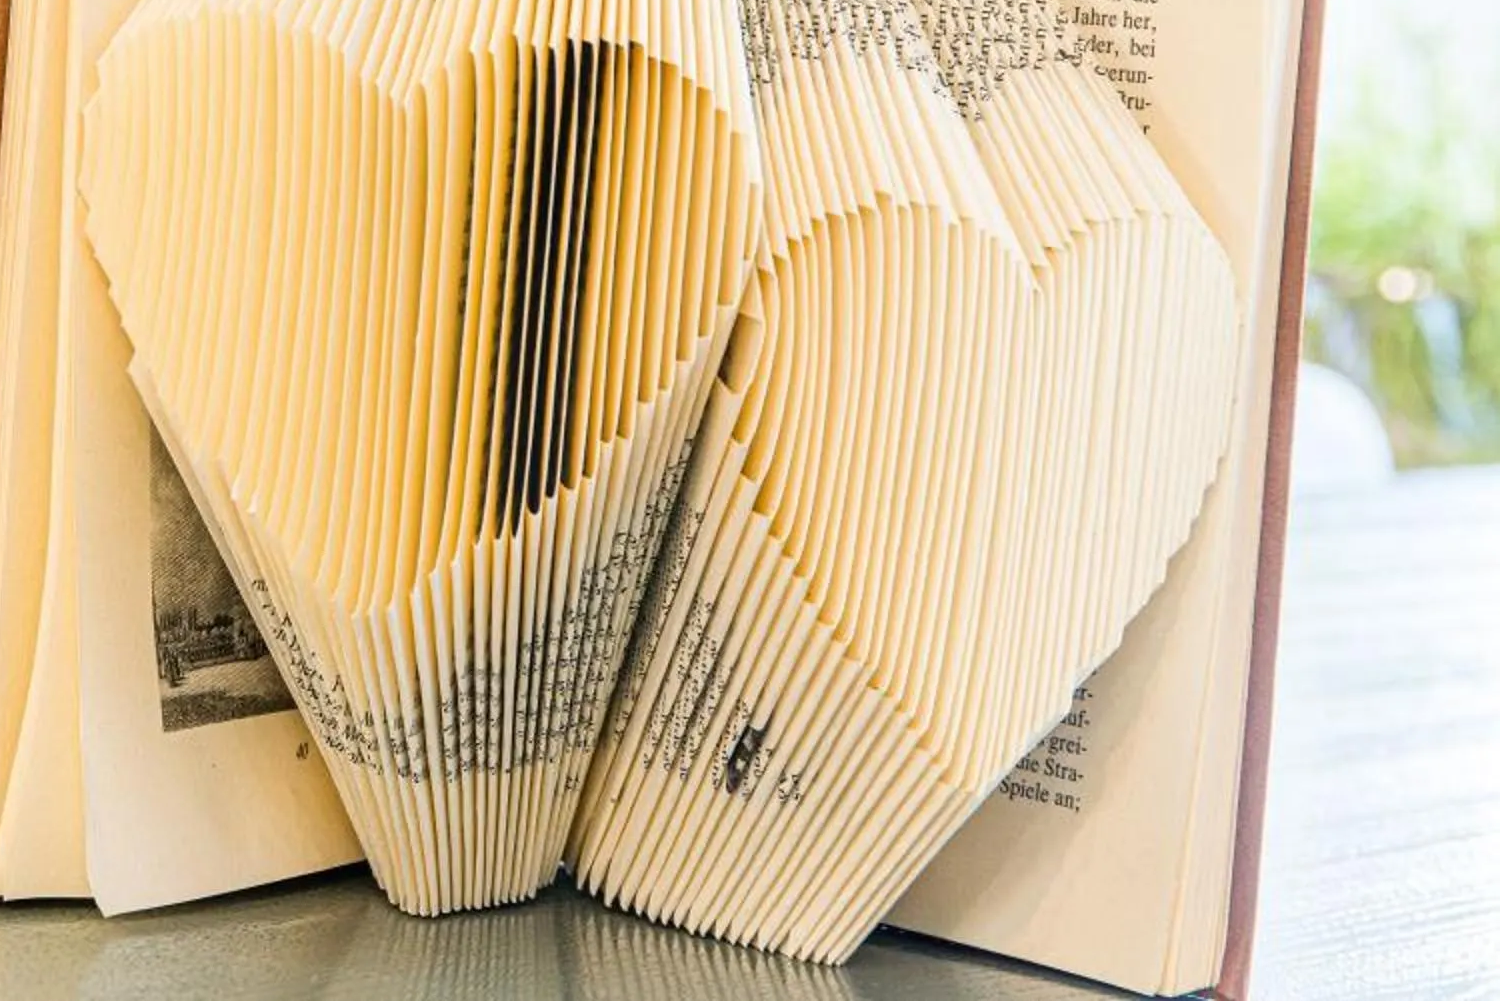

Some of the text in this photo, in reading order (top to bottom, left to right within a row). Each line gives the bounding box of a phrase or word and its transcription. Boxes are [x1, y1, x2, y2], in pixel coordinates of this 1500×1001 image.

[1071, 6, 1157, 33] Jahre her,
[1130, 38, 1155, 58] bei
[1048, 736, 1087, 755] grei-
[1044, 758, 1084, 781] Stra-
[1000, 775, 1081, 813] Spiele an;
